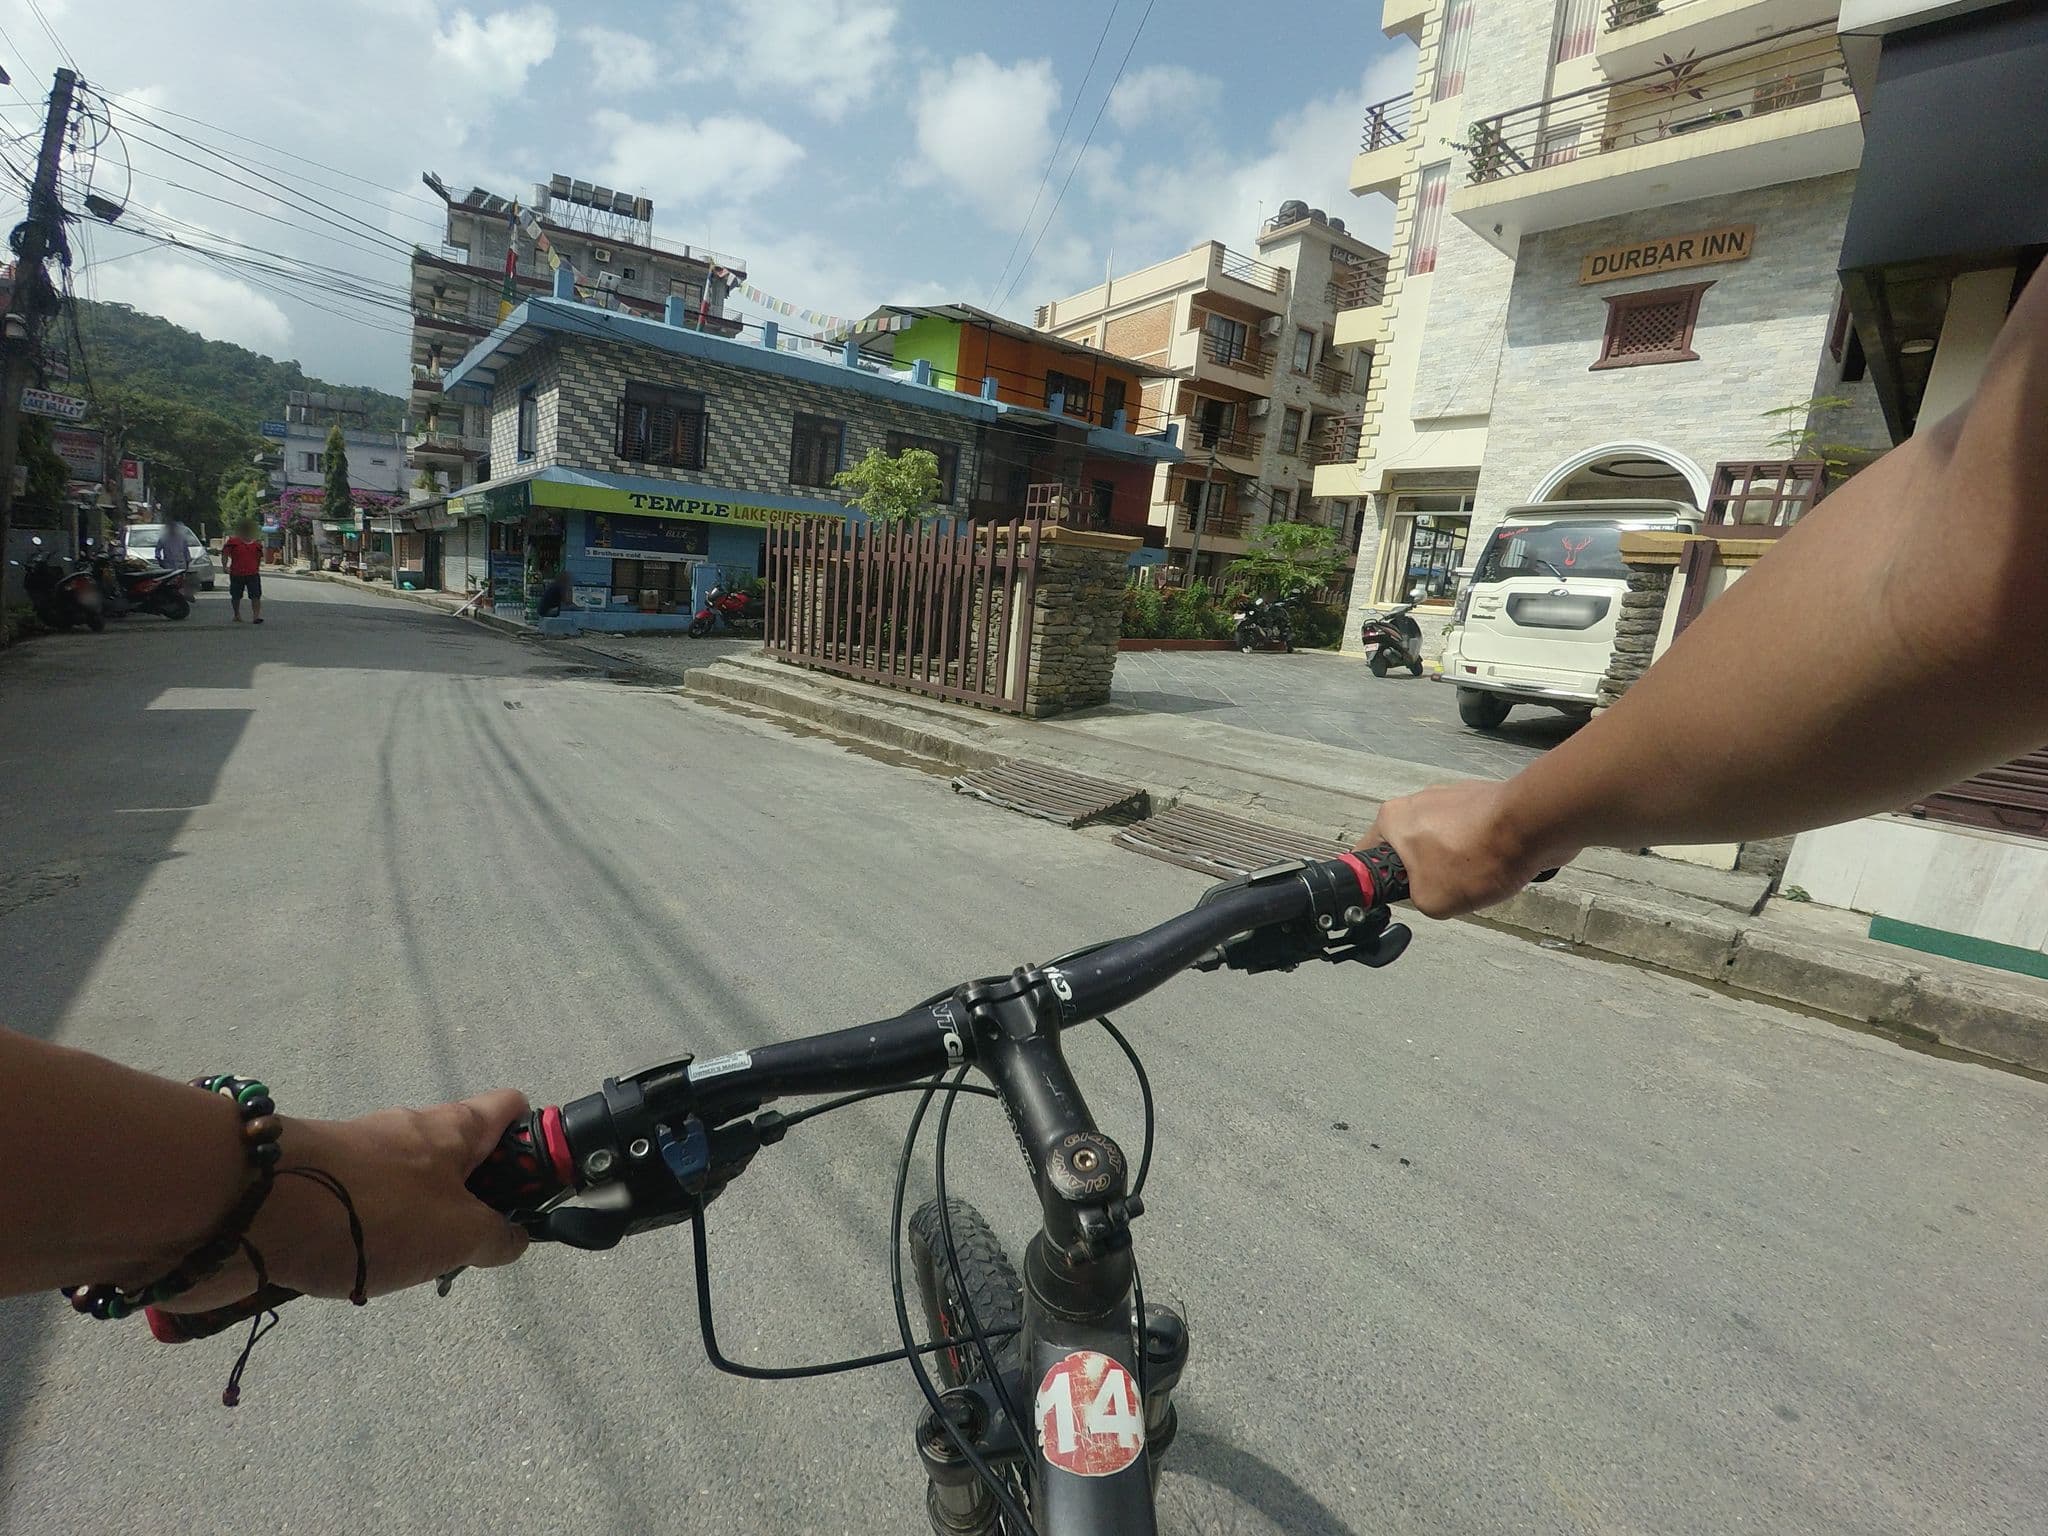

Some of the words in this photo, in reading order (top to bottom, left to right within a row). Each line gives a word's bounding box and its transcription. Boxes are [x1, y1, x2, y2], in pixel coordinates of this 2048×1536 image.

[1591, 239, 1694, 276] DURBAR
[1701, 231, 1745, 257] INN
[26, 389, 73, 406] HOTEL
[629, 493, 730, 518] TEMPLE
[733, 506, 766, 522] LAKE
[592, 550, 624, 558] Brothers
[1036, 1368, 1142, 1454] 14
